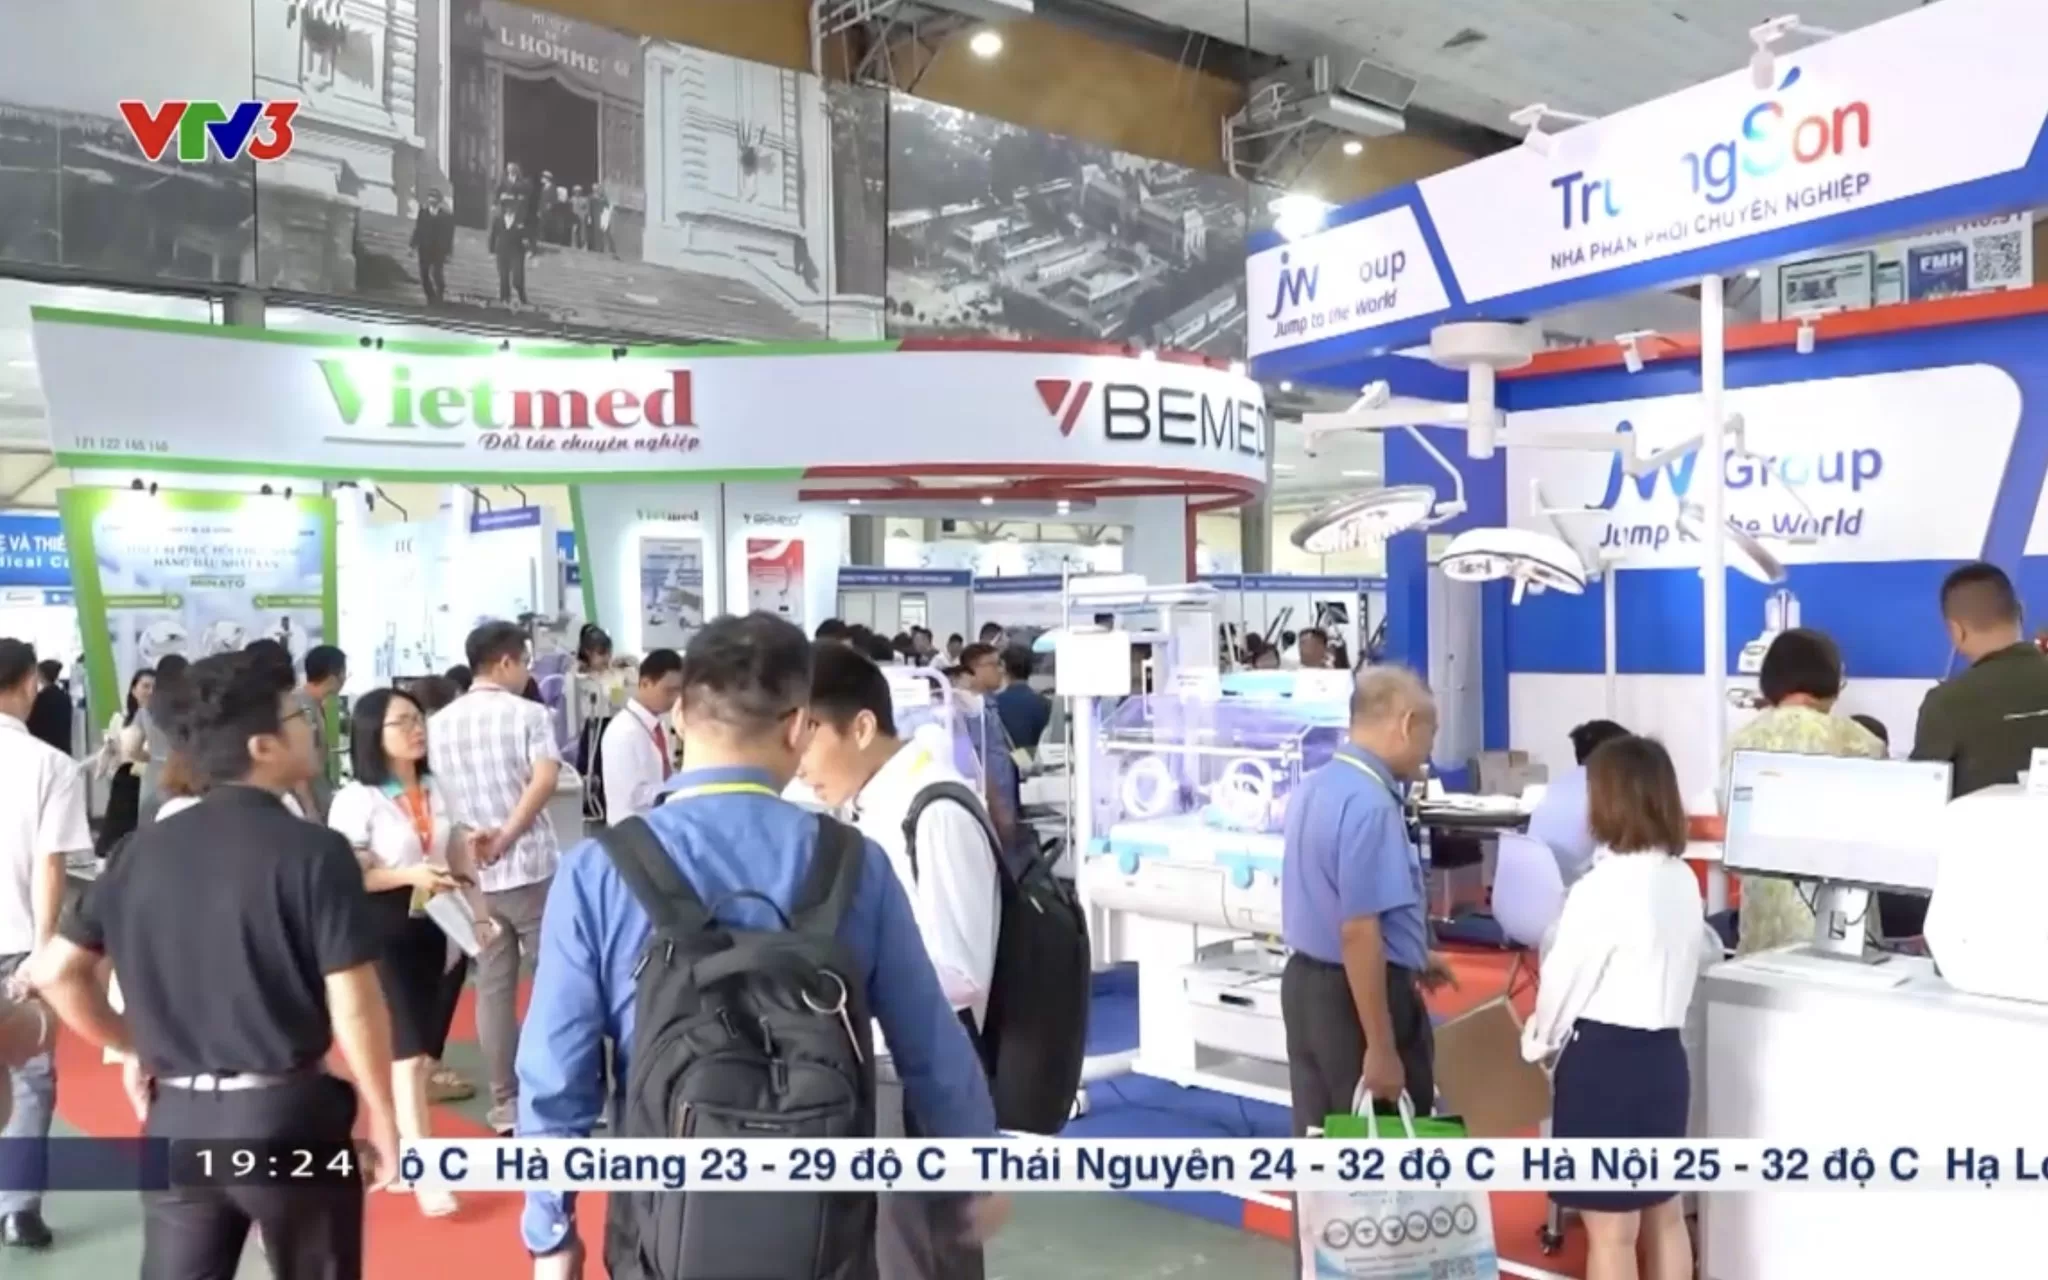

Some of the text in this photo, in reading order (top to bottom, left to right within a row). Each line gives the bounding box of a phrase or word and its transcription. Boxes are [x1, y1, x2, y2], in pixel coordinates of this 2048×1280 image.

[1273, 315, 1308, 339] Jump
[315, 359, 700, 431] Vietmed
[1723, 447, 1884, 492] Group
[1599, 522, 1670, 551] Jump
[1772, 507, 1864, 537] World
